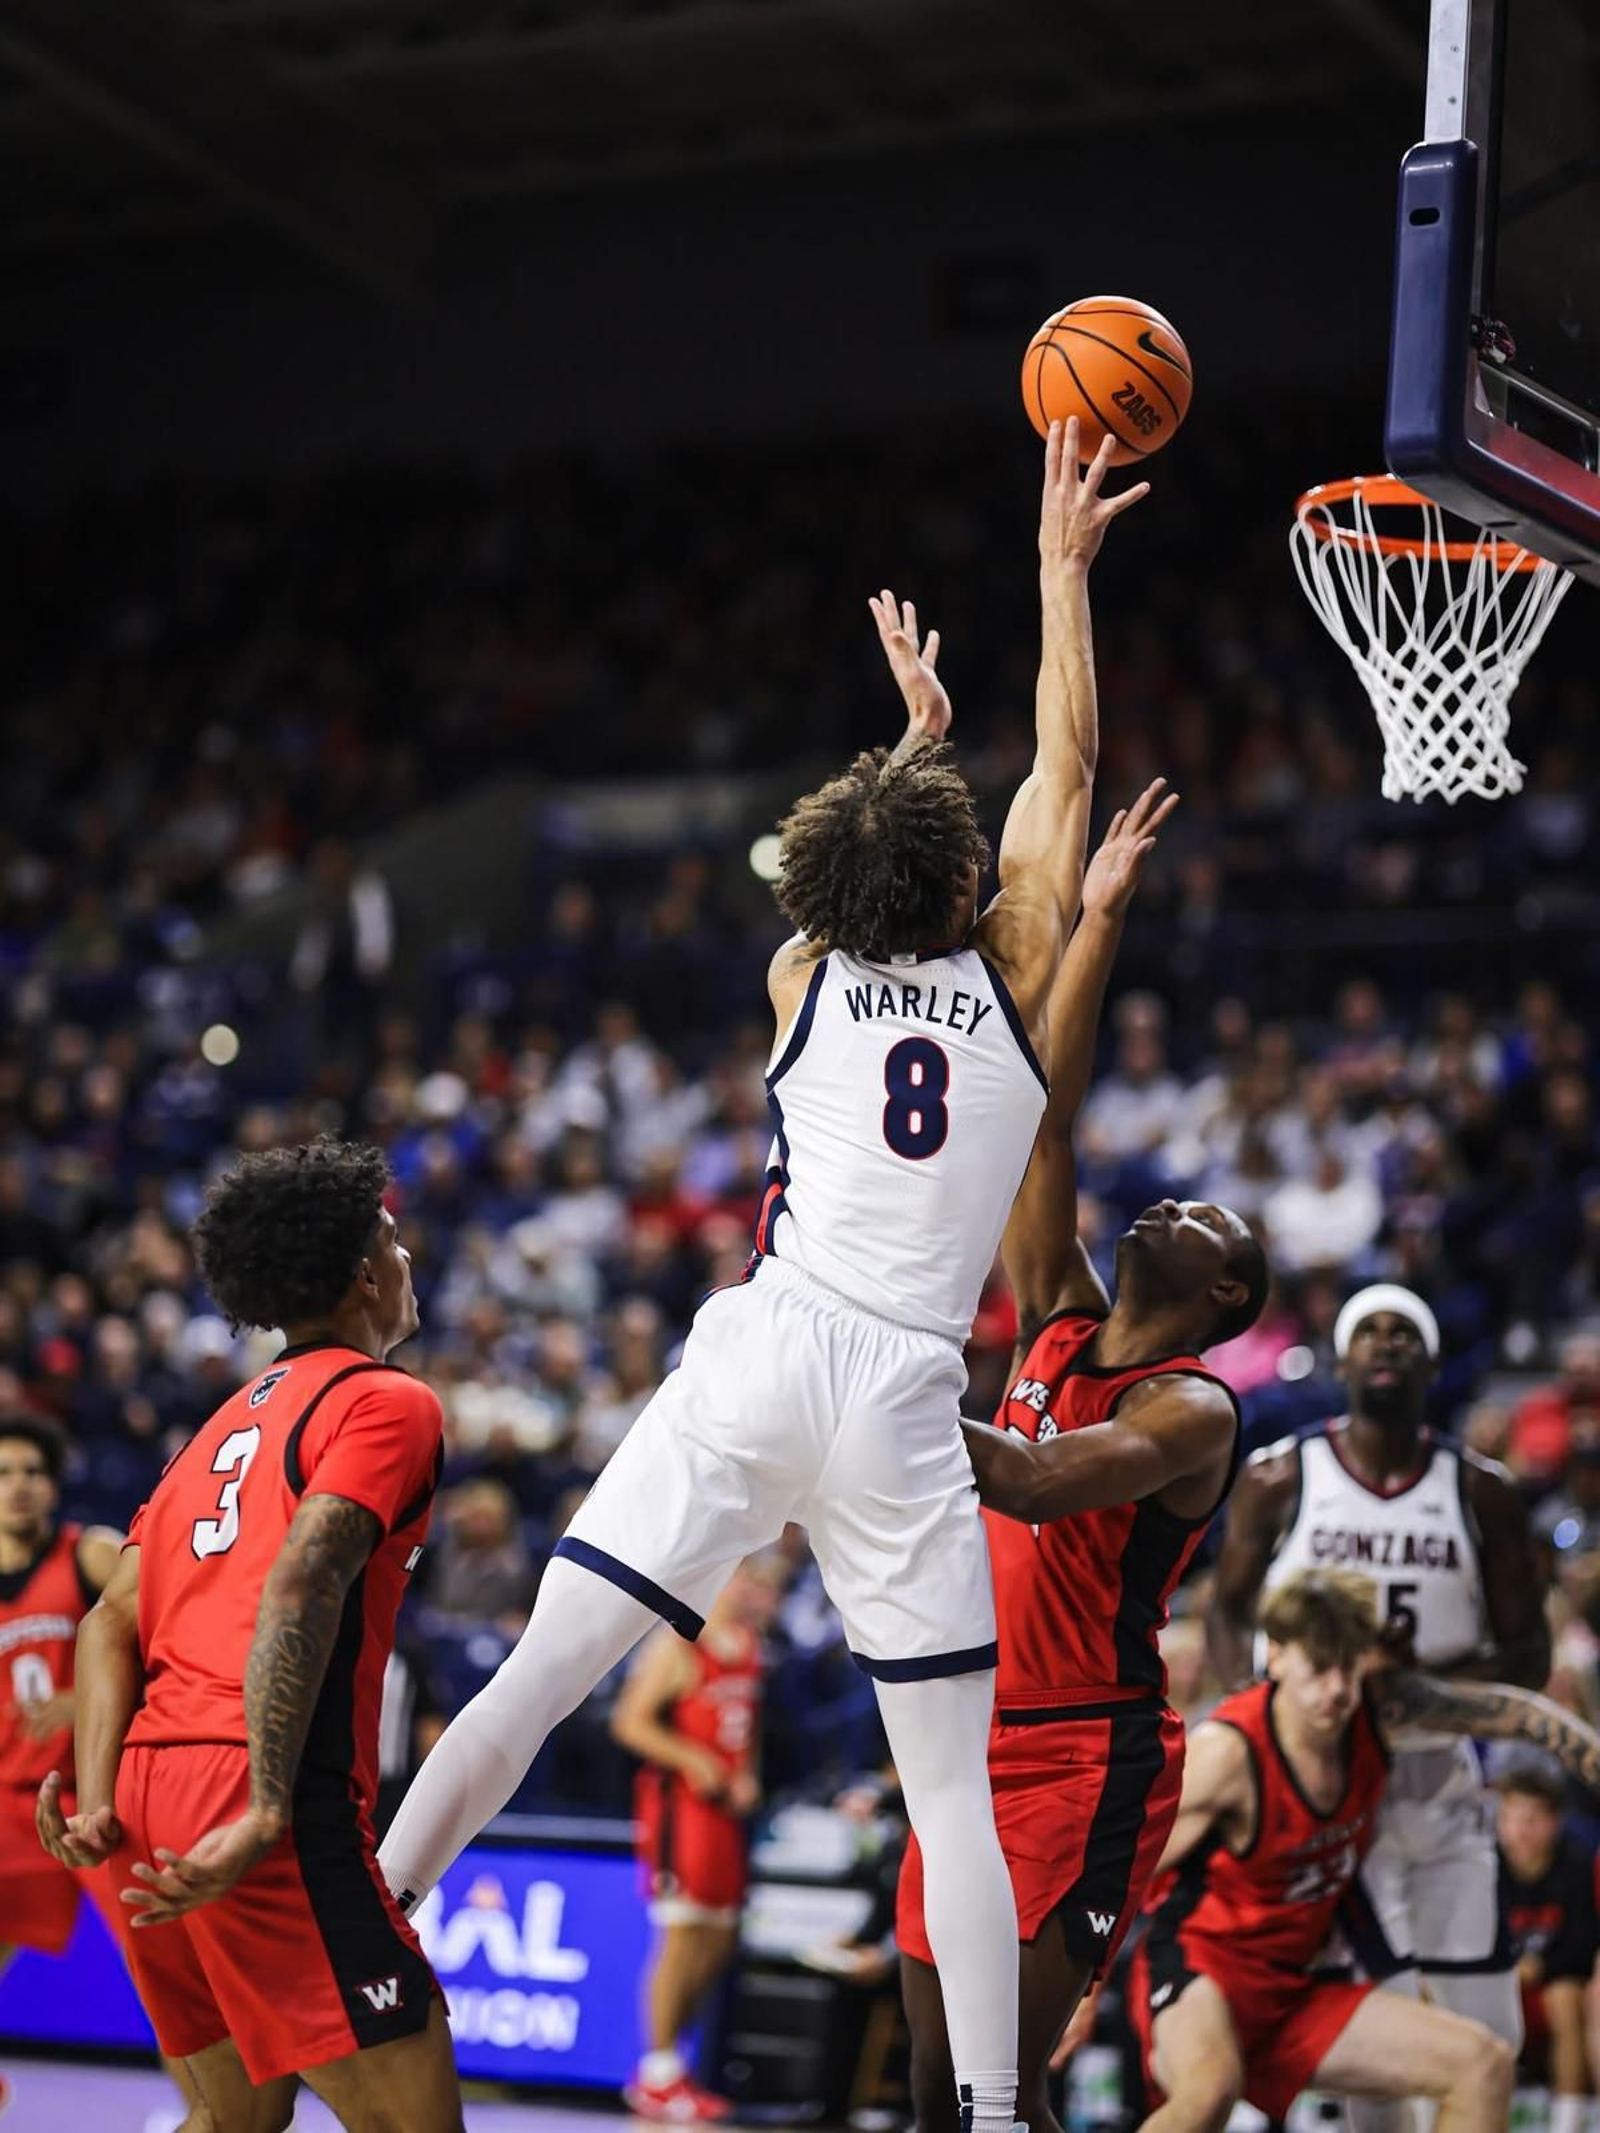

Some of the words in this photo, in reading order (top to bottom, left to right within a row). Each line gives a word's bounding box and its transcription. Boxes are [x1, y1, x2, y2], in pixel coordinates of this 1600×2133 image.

[1111, 381, 1163, 436] ZAGS
[845, 984, 993, 1036] WARLEY
[882, 1036, 950, 1161] 8
[191, 1423, 261, 1561] 3
[1312, 1528, 1460, 1572] GONZAGA
[11, 1653, 54, 1718] 0
[1086, 1910, 1117, 1938] W
[360, 1975, 400, 2012] W
